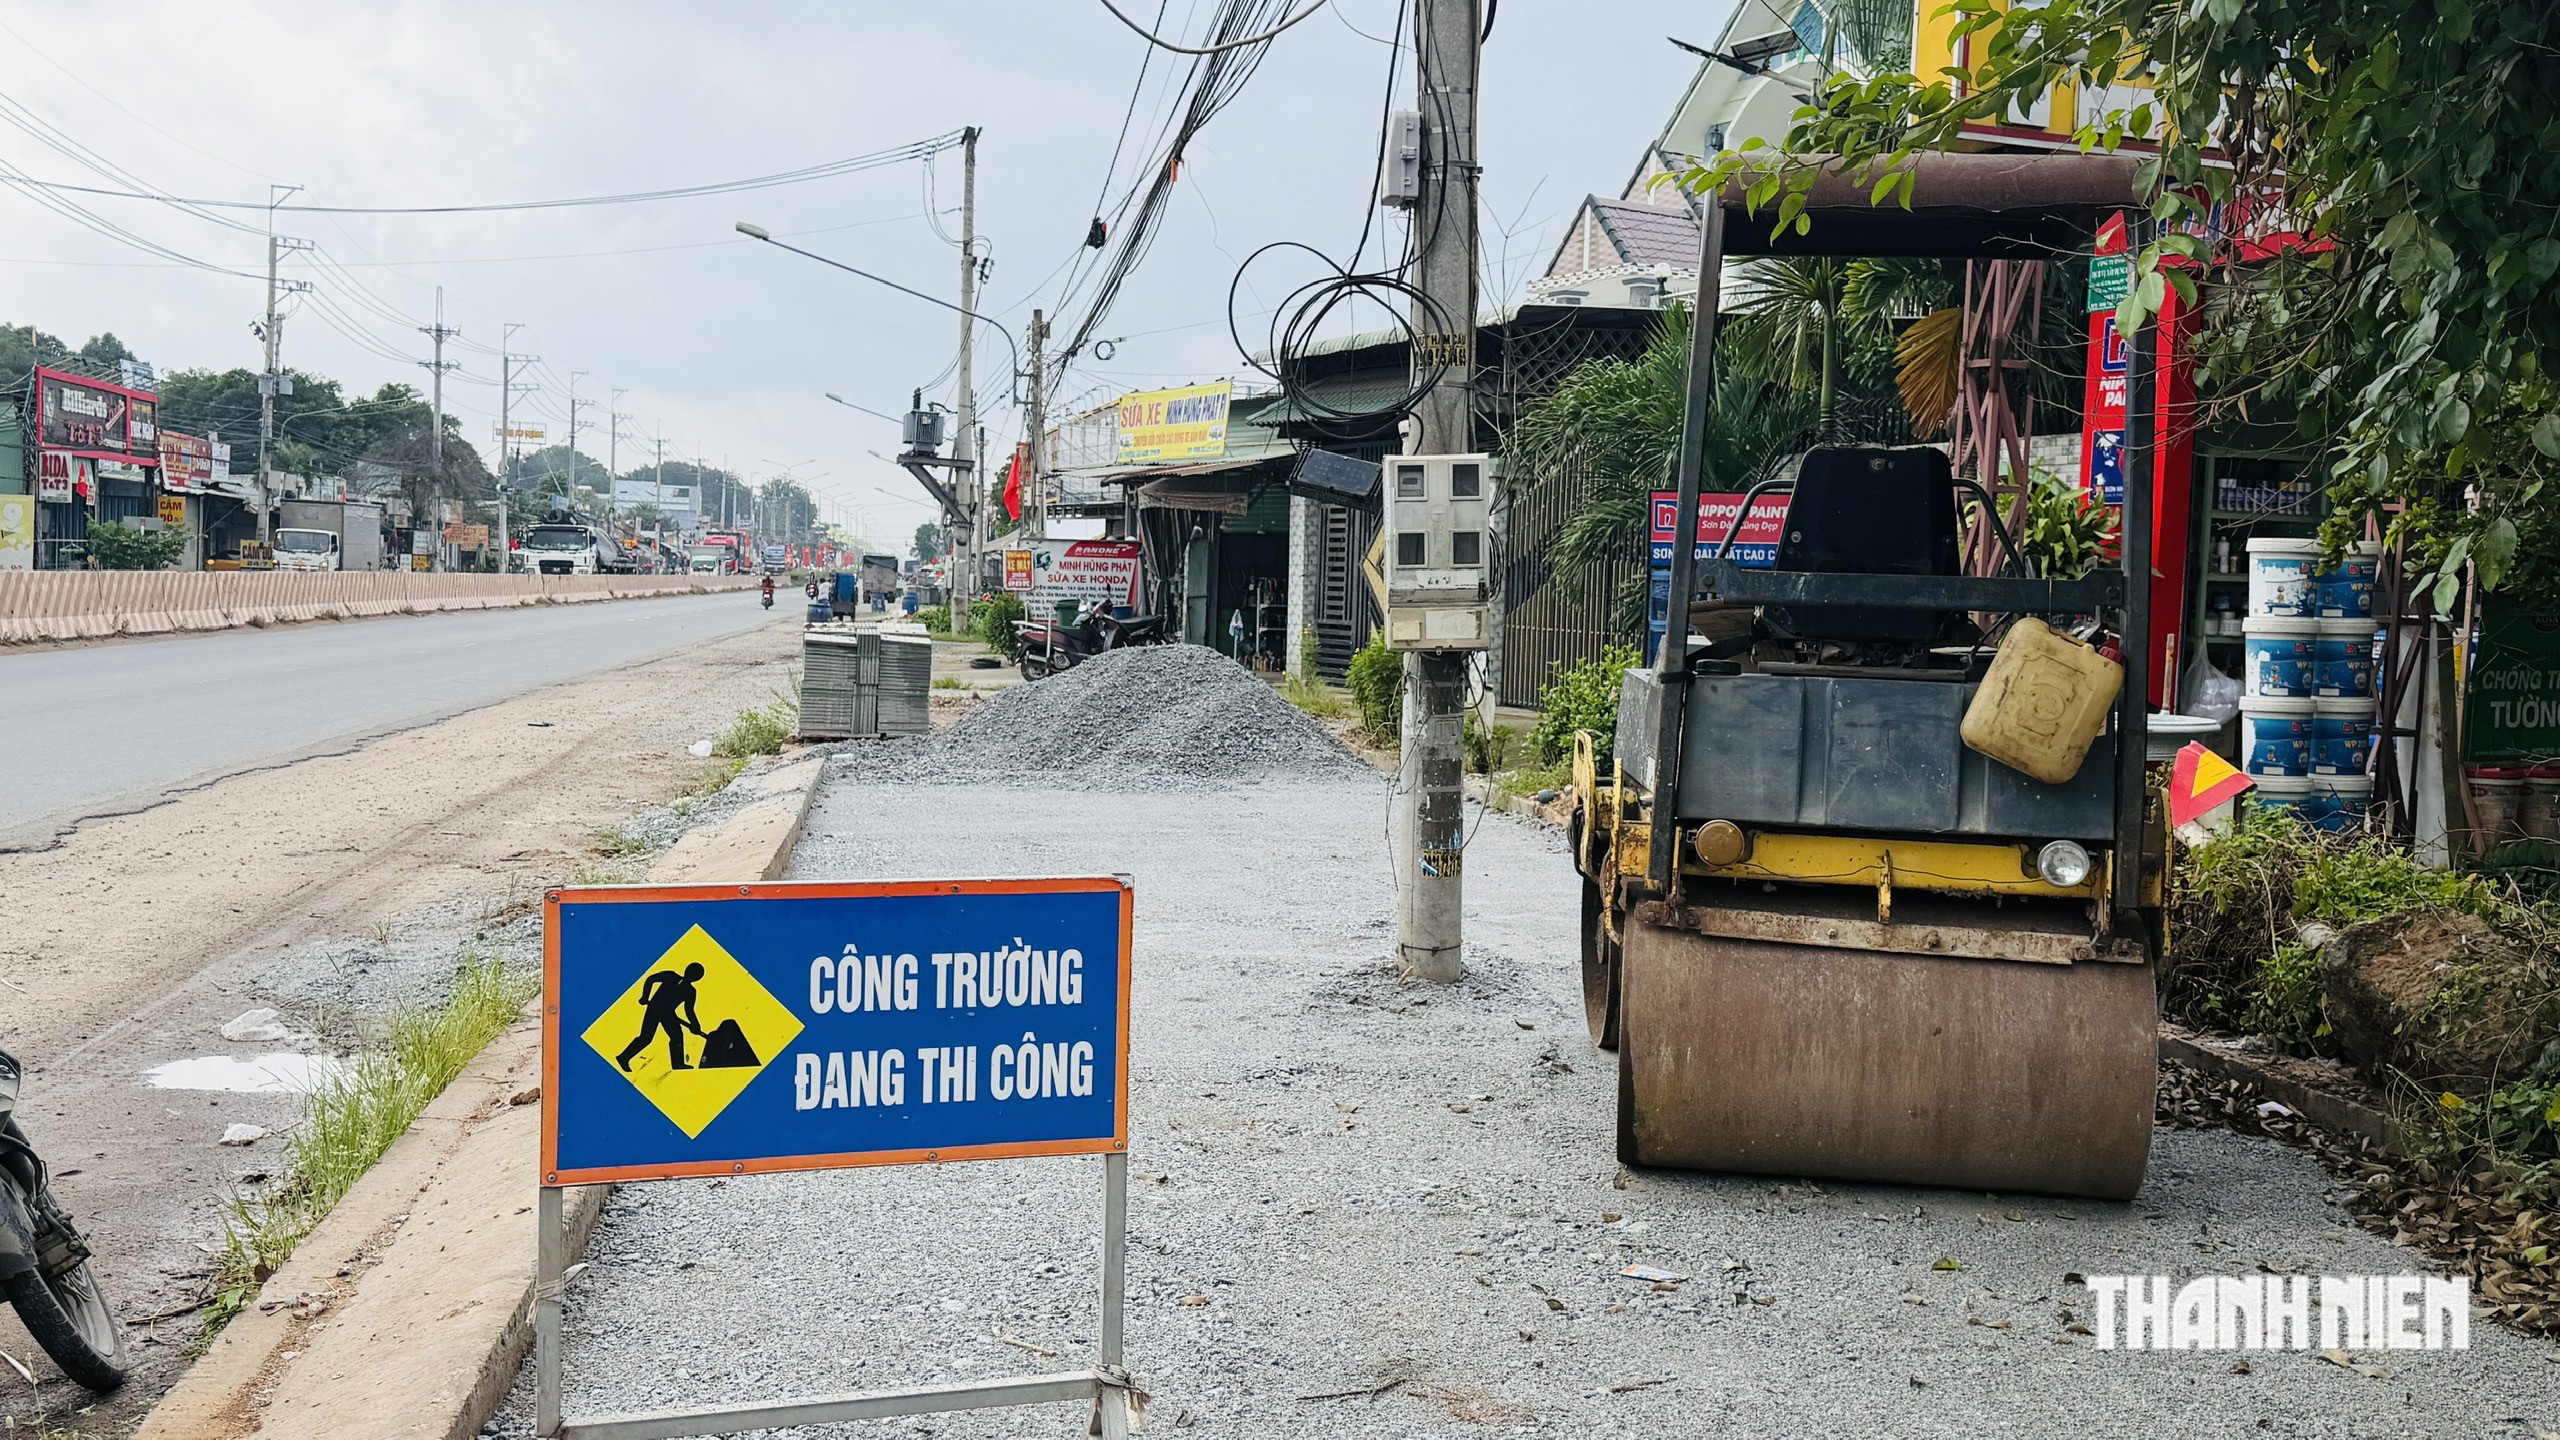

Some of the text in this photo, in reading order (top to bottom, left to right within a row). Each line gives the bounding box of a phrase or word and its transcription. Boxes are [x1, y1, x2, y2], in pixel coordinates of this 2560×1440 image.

[1121, 397, 1143, 429] SỬA
[1146, 402, 1162, 426] XE
[41, 453, 69, 478] BIDA
[1698, 505, 1788, 518] NIPPO PAINT
[1702, 520, 1718, 529] Sơn
[1761, 521, 1778, 533] Đẹp
[1743, 550, 1765, 560] CAO
[1059, 558, 1132, 572] MINH HÙNG PHÁT
[1048, 571, 1128, 585] SỬA XE HONDA
[809, 937, 1084, 1014] CÔNG TRƯỜNG
[795, 1032, 1094, 1111] ĐANG THI CÔNG
